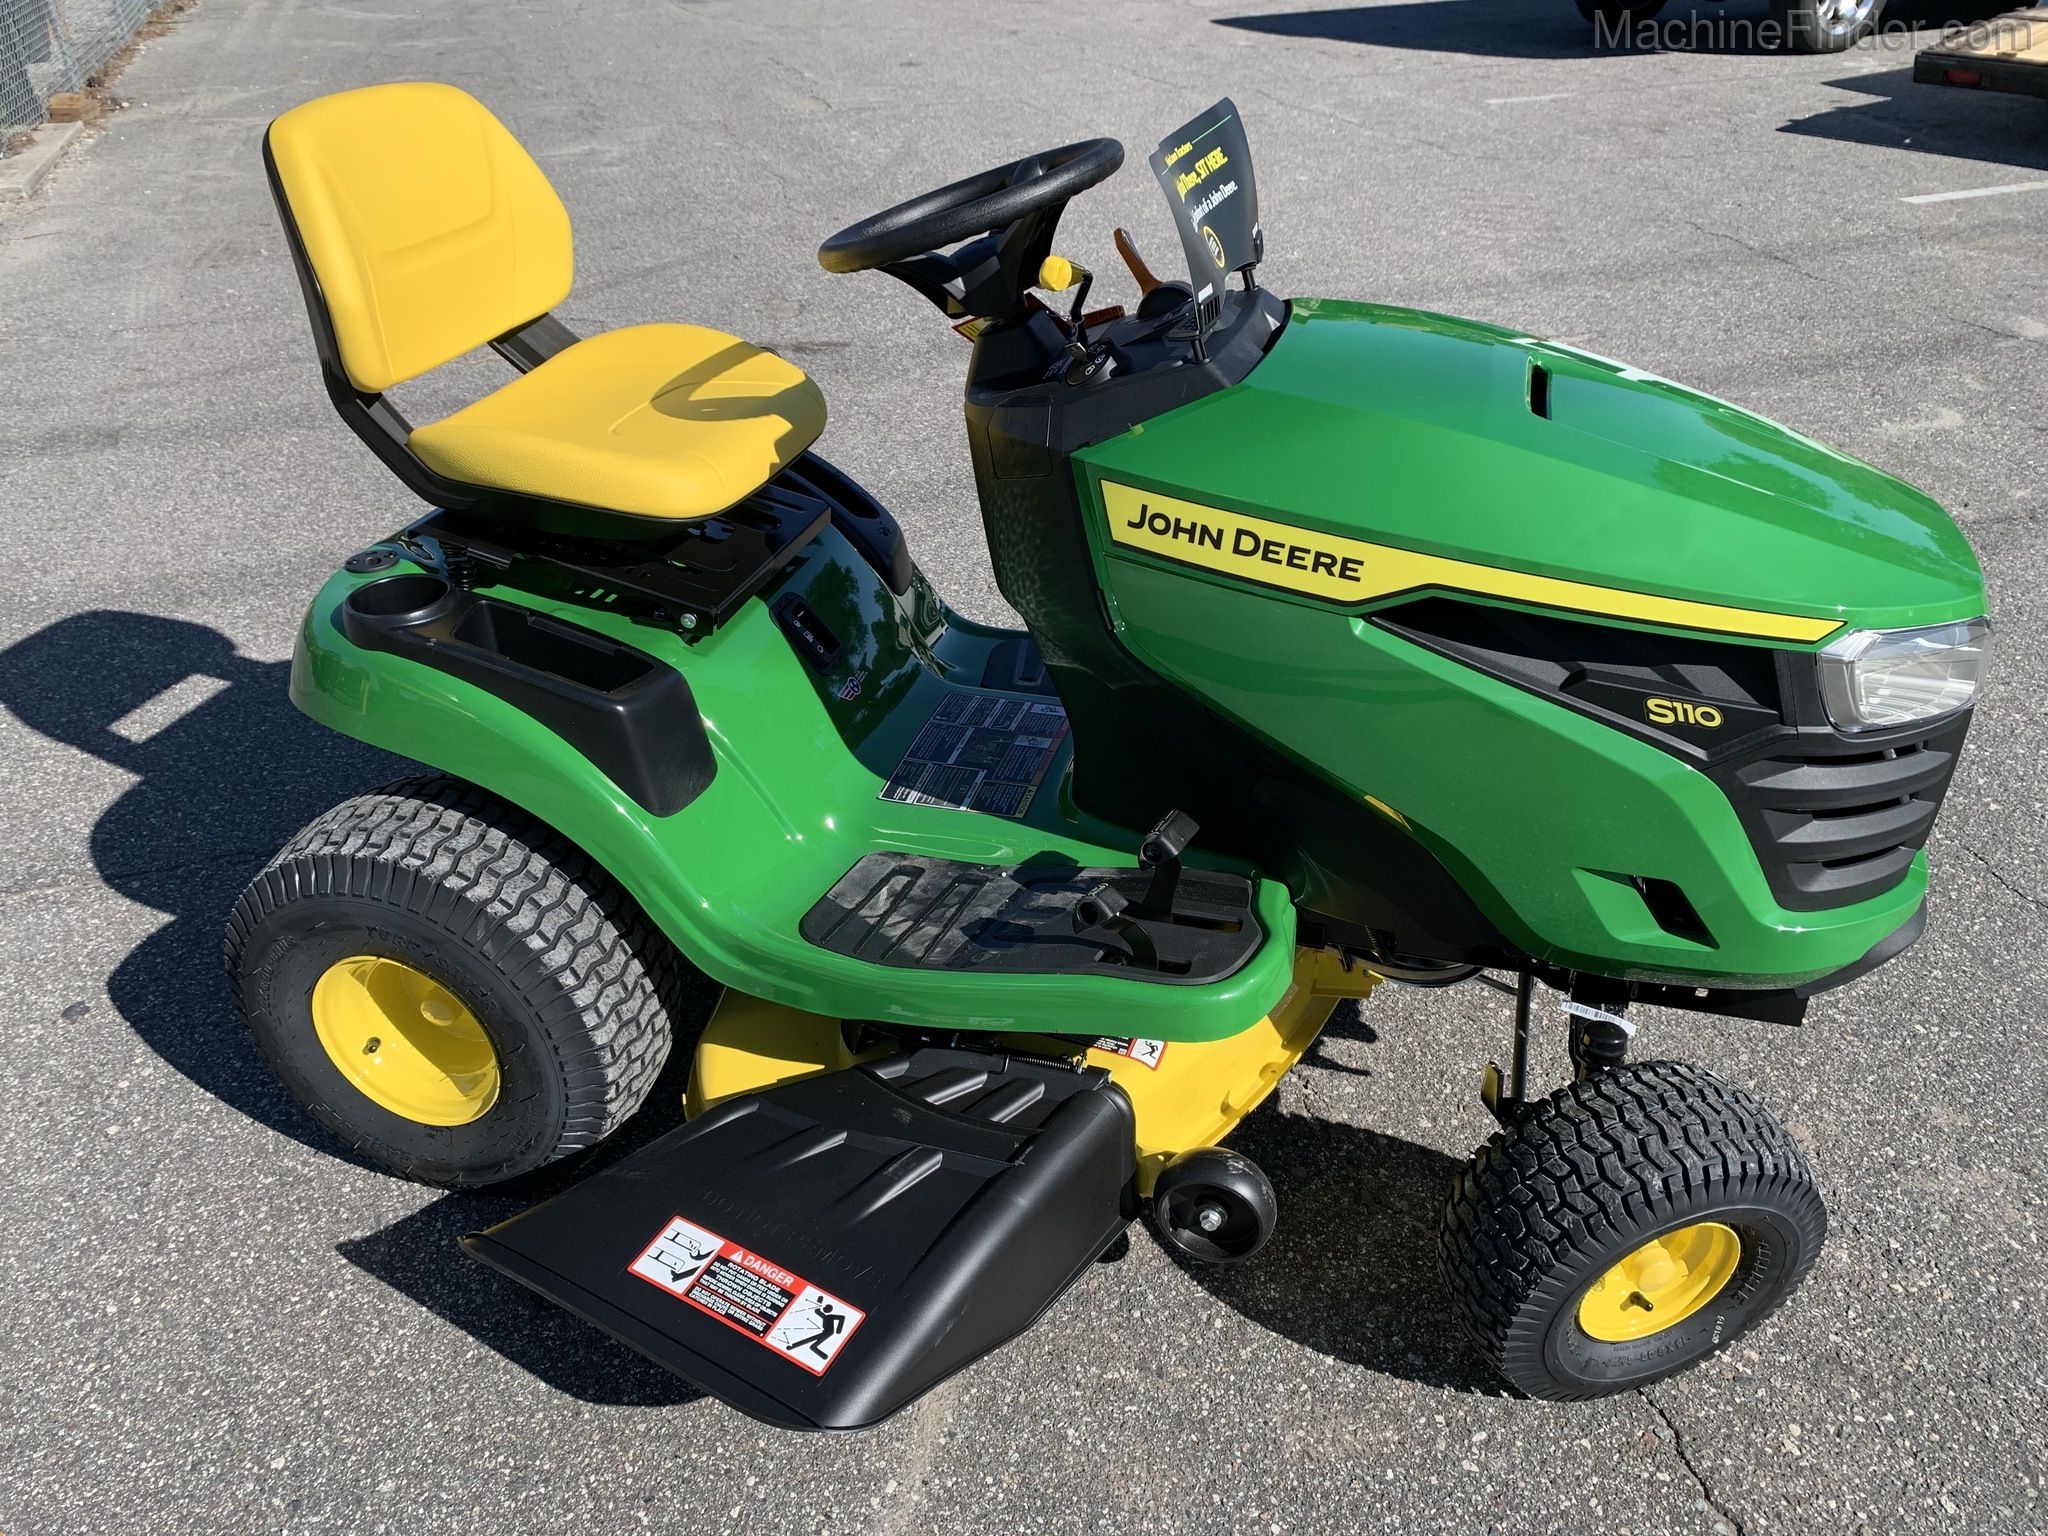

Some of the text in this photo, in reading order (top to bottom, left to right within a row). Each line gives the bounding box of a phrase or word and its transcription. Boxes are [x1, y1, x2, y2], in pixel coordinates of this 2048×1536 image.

[1195, 158, 1210, 180] SIT
[1127, 504, 1365, 582] JOHN DEERE
[1646, 698, 1721, 728] S110
[727, 1261, 781, 1293] ROTATING BLADE
[742, 1254, 795, 1287] DANGER
[714, 1274, 772, 1307] THROWN OBJECTS
